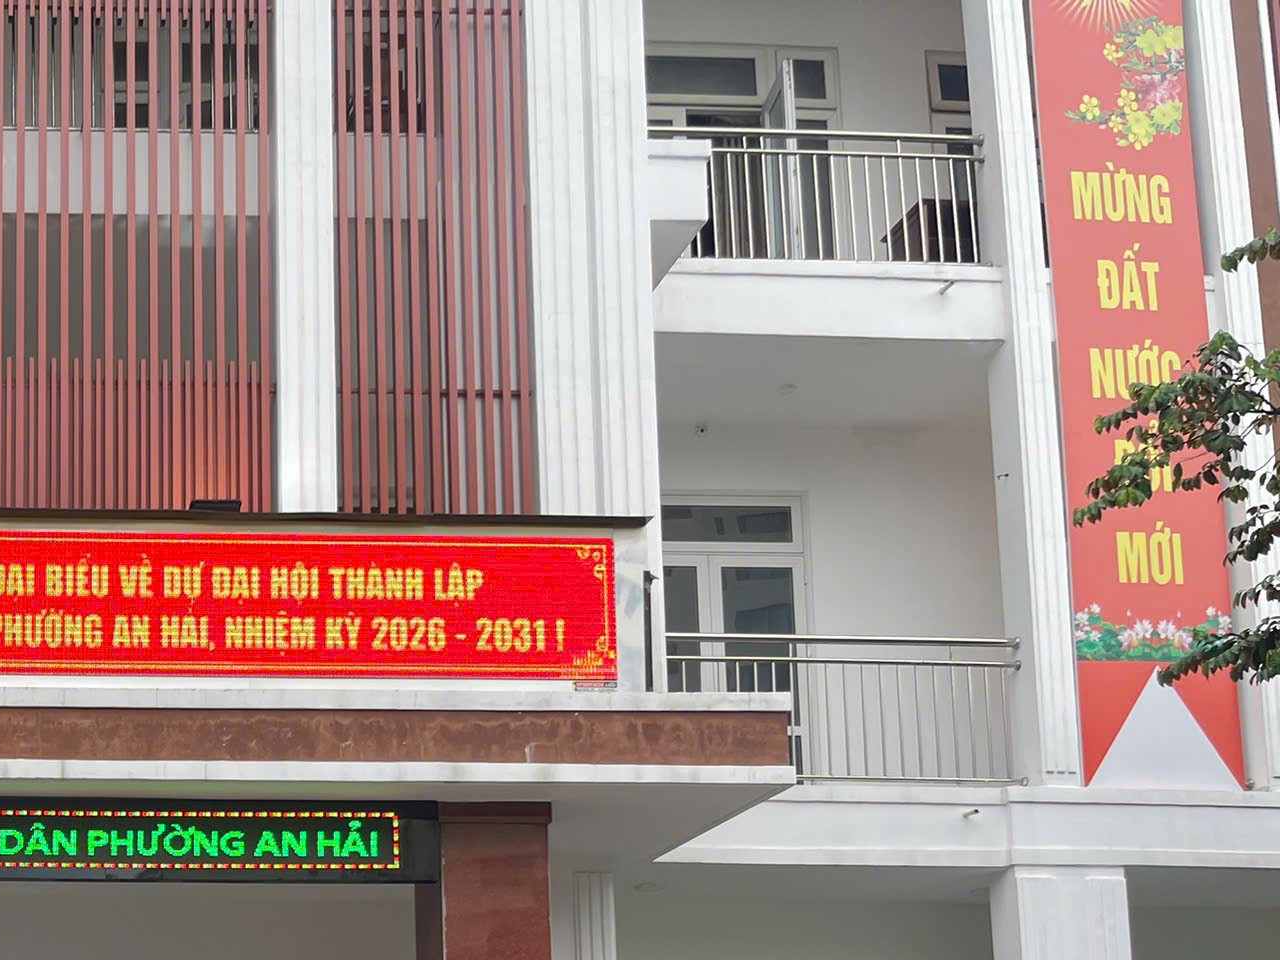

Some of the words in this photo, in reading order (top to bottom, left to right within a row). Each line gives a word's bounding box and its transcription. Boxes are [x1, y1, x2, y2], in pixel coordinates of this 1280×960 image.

[1070, 161, 1173, 225] MỪNG
[1096, 242, 1160, 312] ĐẤT
[1089, 339, 1183, 402] NƯỚC
[45, 553, 109, 598] BIỂU
[118, 553, 154, 598] VỀ
[163, 560, 205, 605] DỰ
[270, 561, 319, 606] HỘI
[328, 561, 424, 601] THÀNH
[433, 562, 484, 608] LẬP
[1116, 521, 1185, 586] MỚI
[112, 614, 150, 649] AN
[225, 610, 316, 656] NHIỆM
[370, 616, 447, 651] 2026
[475, 617, 546, 652] 2031
[555, 618, 566, 652] !
[0, 822, 78, 856] DÂN
[87, 823, 245, 857] PHƯỜNG
[253, 831, 308, 857] AN
[317, 820, 379, 857] HẢI
